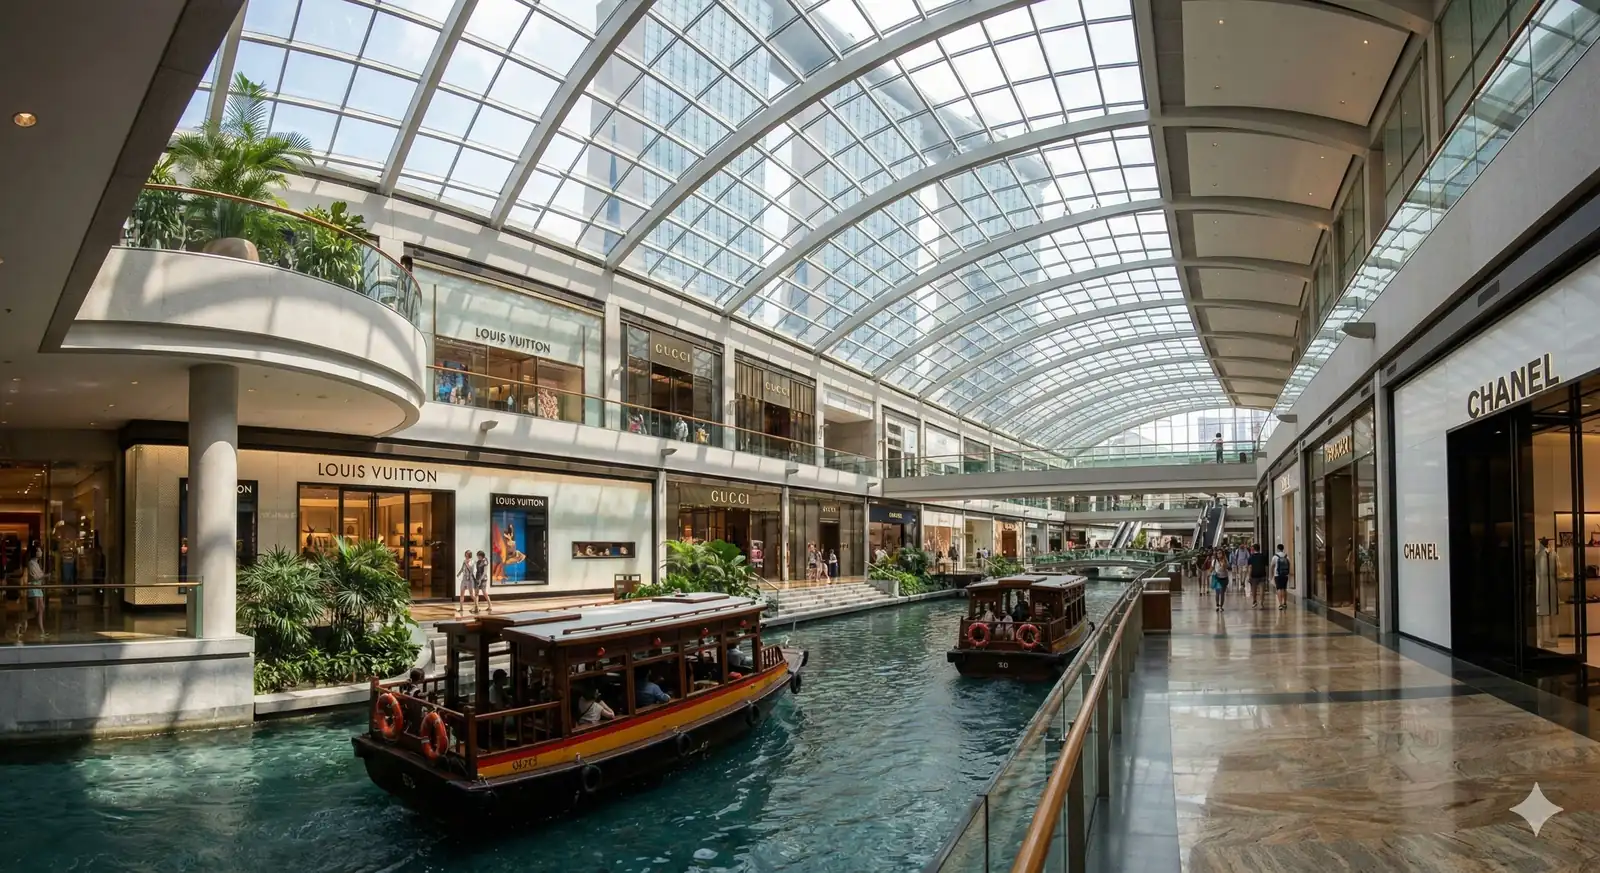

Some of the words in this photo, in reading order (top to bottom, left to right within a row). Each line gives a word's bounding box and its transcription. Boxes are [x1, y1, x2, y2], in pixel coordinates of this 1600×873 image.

[475, 327, 506, 343] LOUIS
[508, 334, 551, 353] VUITTON
[655, 343, 691, 363] GUCCI
[765, 381, 790, 397] GUCCI
[1467, 352, 1560, 419] CHANEL
[318, 462, 365, 479] LOUIS
[371, 465, 437, 483] VUITTON
[495, 496, 516, 506] LOUIS
[516, 497, 544, 507] VUITTON
[711, 490, 750, 505] GUCCI
[1403, 543, 1439, 560] CHANEL
